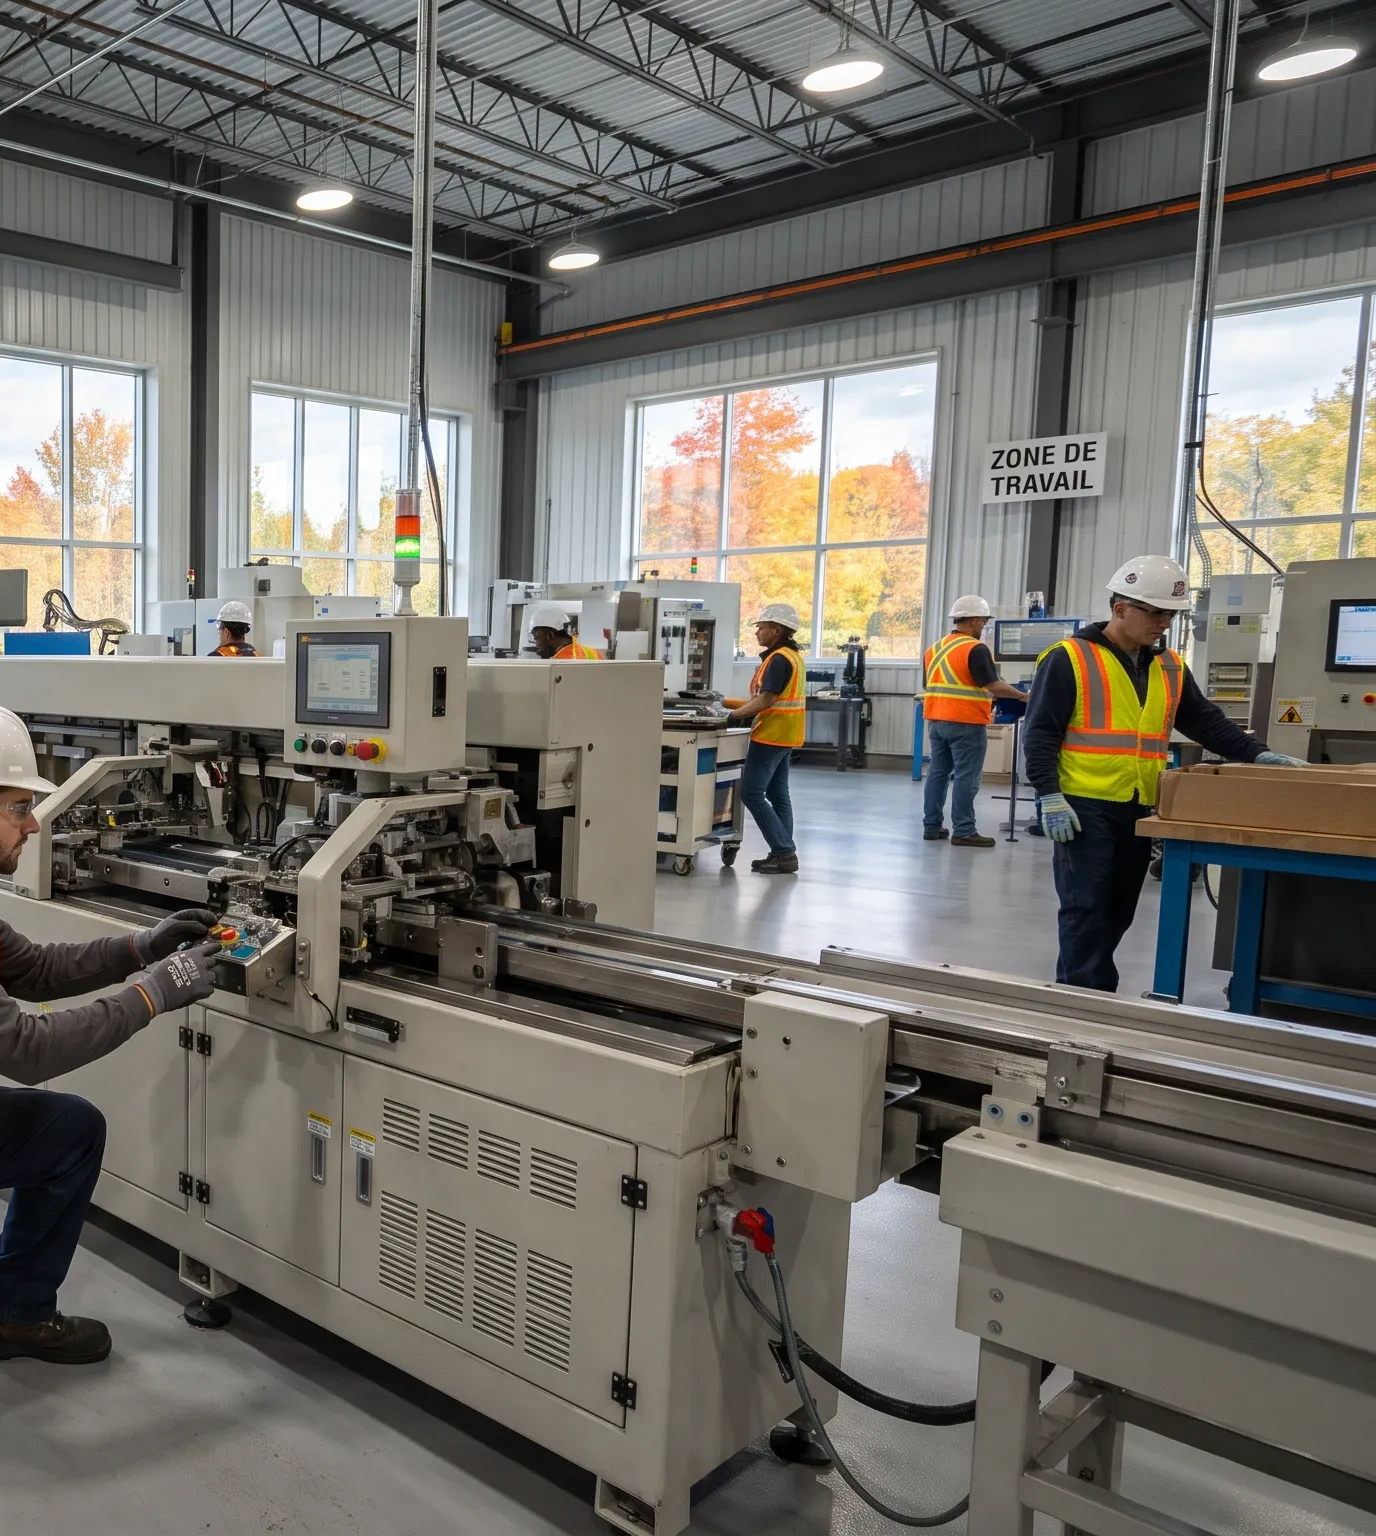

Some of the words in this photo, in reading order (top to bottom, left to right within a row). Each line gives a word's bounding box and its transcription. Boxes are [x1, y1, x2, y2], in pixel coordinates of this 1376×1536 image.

[990, 444, 1056, 470] ZONE
[1064, 440, 1098, 464] DE
[990, 469, 1094, 497] TRAVAIL
